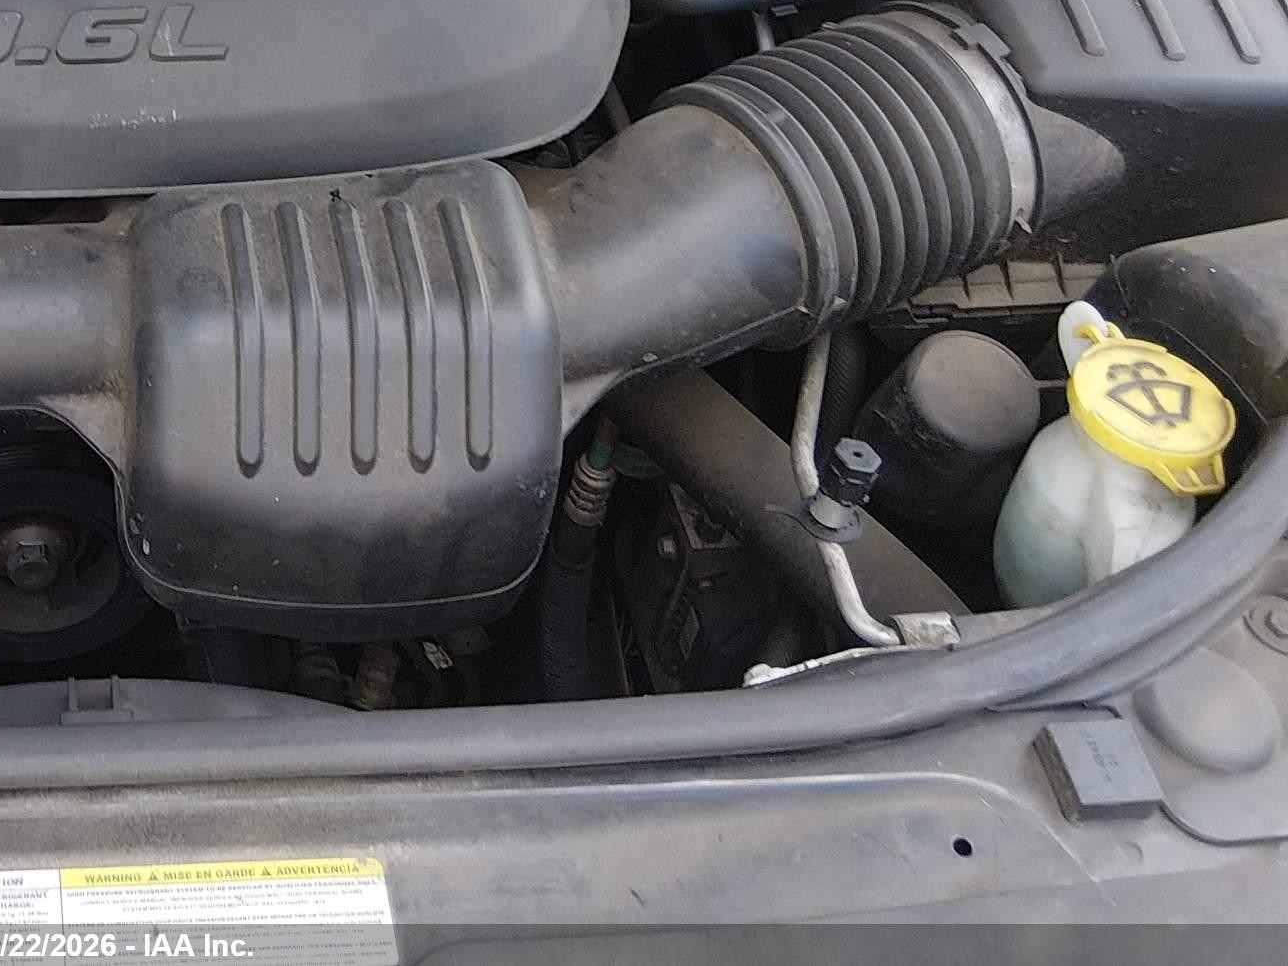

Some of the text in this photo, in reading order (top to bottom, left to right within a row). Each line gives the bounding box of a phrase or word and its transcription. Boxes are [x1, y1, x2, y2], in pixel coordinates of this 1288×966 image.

[84, 863, 360, 884] WARNING MISE EN GARDE ADVERTENCIA
